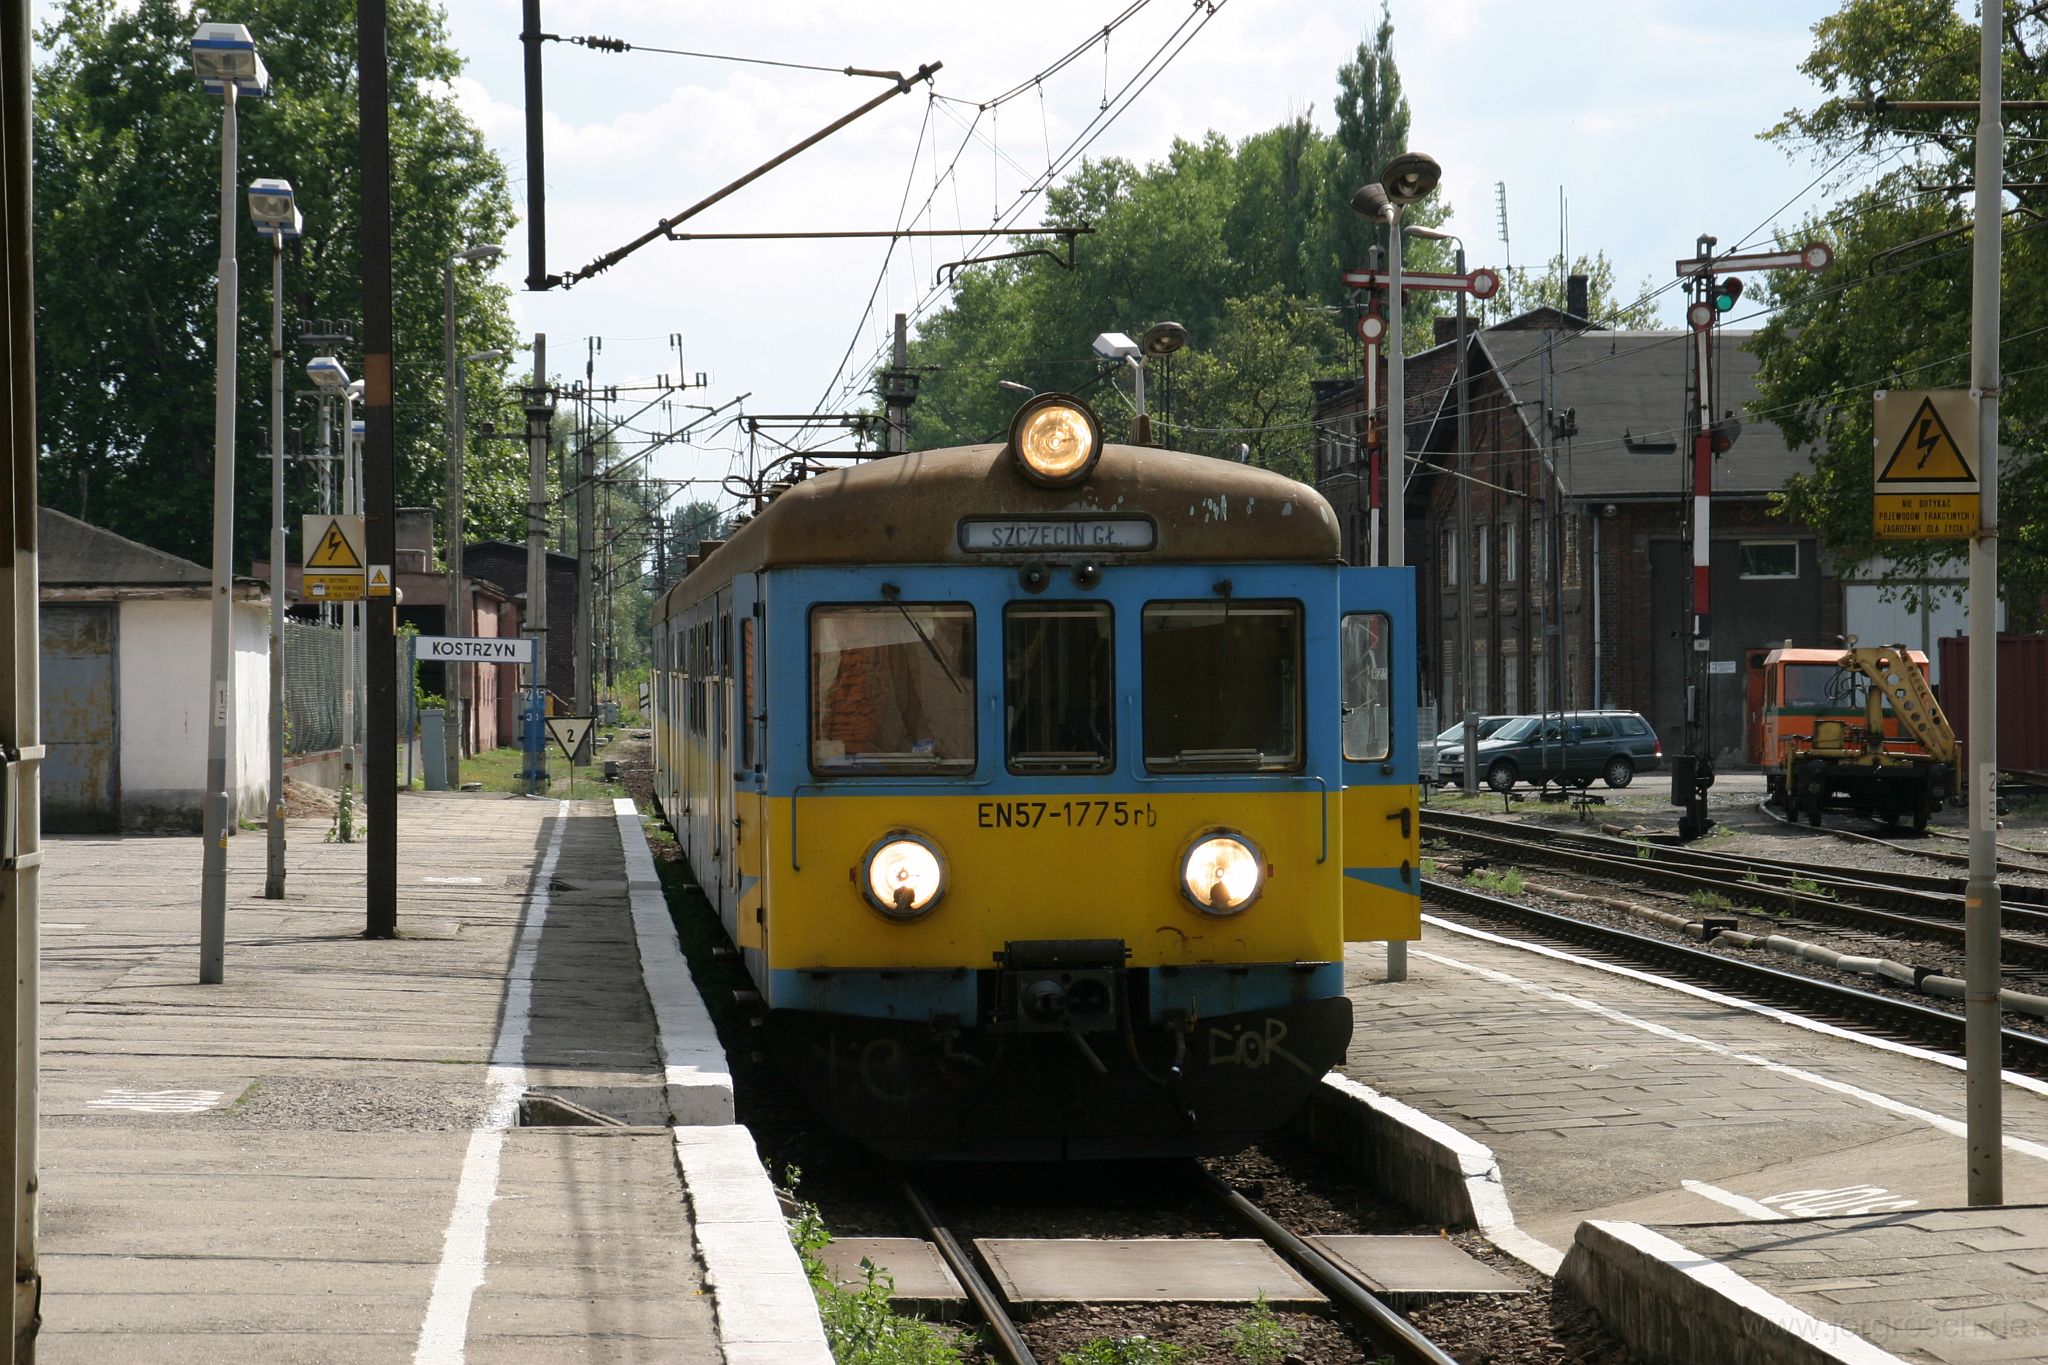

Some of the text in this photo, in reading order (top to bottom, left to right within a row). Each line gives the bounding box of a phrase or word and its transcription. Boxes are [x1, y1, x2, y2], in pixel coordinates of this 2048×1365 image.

[1902, 499, 1913, 509] NIE
[992, 525, 1085, 547] SZCZECIN
[1926, 524, 1940, 534] DLA
[432, 641, 516, 657] KOSTRZYN
[567, 729, 575, 743] 2
